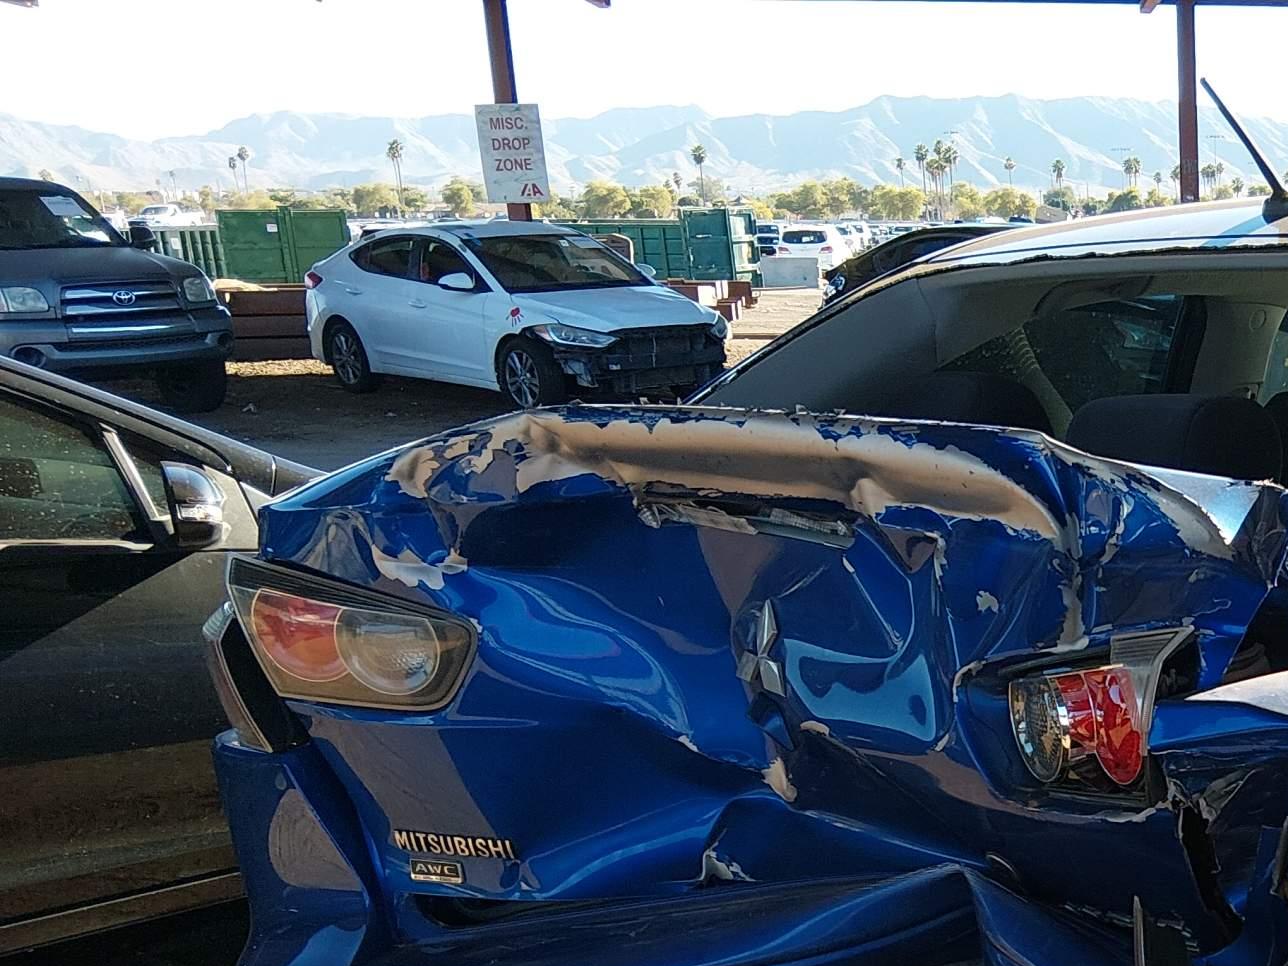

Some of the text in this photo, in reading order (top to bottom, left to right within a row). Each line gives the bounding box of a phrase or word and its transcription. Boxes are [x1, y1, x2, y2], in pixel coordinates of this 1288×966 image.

[489, 117, 528, 130] MISC.
[492, 137, 530, 151] DROP
[495, 158, 533, 172] ZONE
[394, 830, 515, 860] MITSUBISHI
[415, 863, 457, 876] AWC
